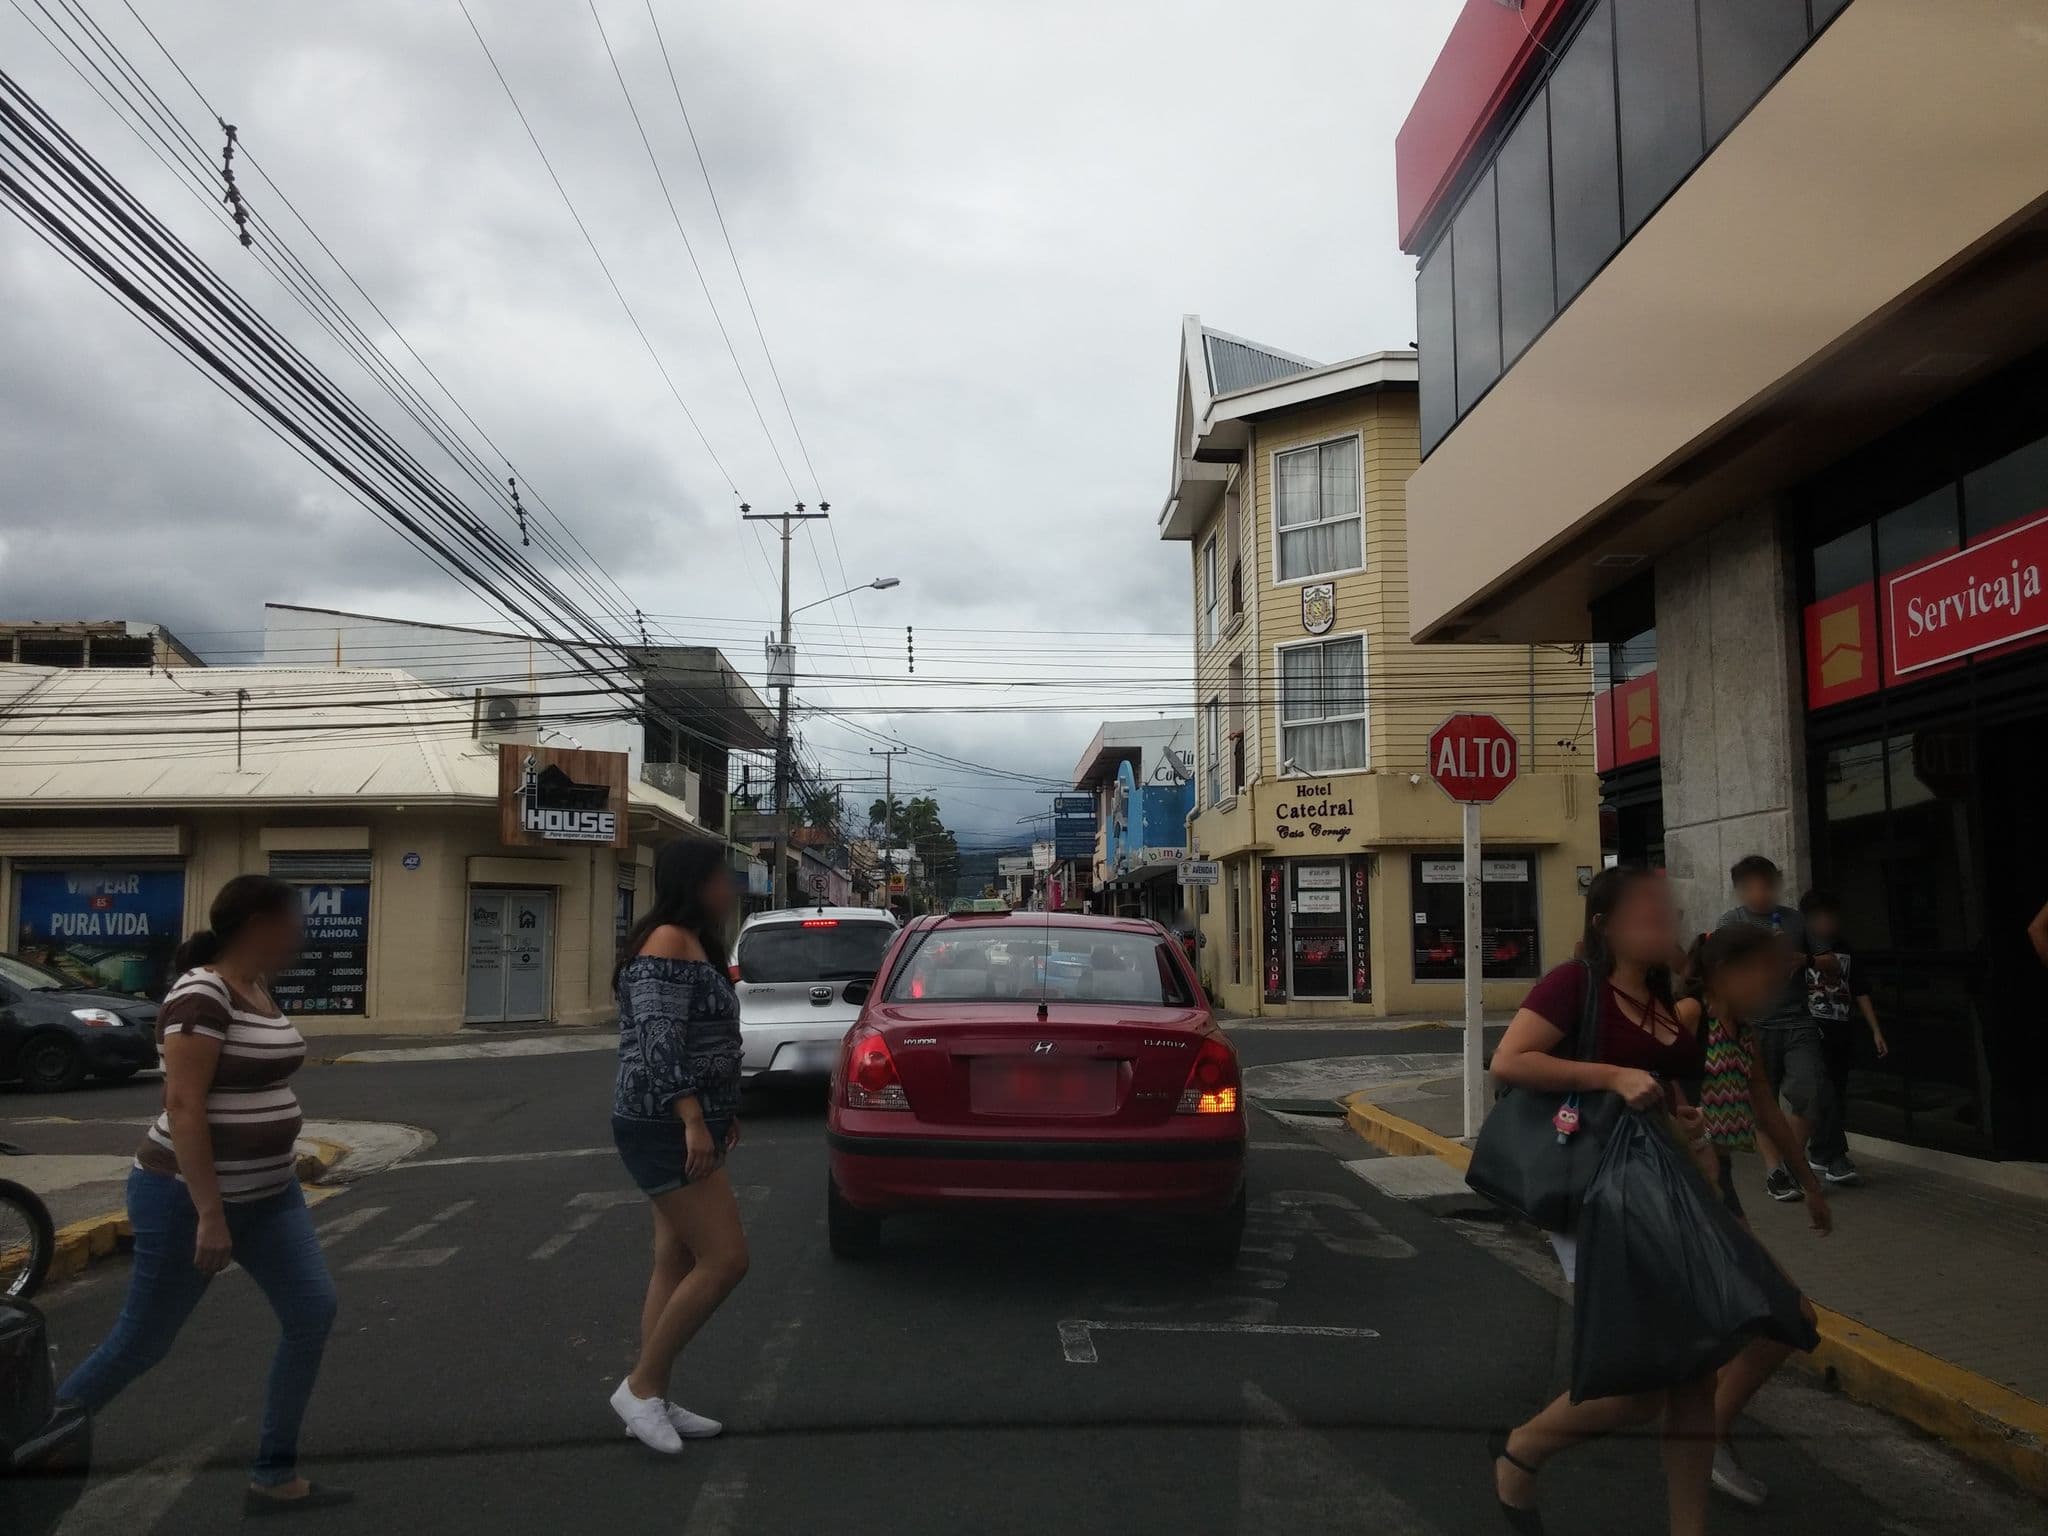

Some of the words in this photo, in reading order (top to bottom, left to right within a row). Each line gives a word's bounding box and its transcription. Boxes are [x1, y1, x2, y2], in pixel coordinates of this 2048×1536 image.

[1907, 558, 2041, 639] Servicaja
[1436, 737, 1511, 778] ALTO
[1296, 783, 1331, 797] Hotel
[1276, 799, 1354, 819] Catedral
[527, 809, 614, 833] HOUSE
[1277, 825, 1304, 839] Casa
[1309, 822, 1351, 842] Cornejo
[96, 898, 106, 907] ES
[1355, 871, 1364, 919] COCINA
[1269, 877, 1278, 942] PERUVIAN
[51, 912, 101, 936] PURA
[105, 912, 150, 936] VIDA
[323, 916, 363, 926] FUMAR
[319, 928, 359, 938] AHORA
[1357, 927, 1365, 983] PERUANA
[903, 1038, 937, 1046] HYUNDAI
